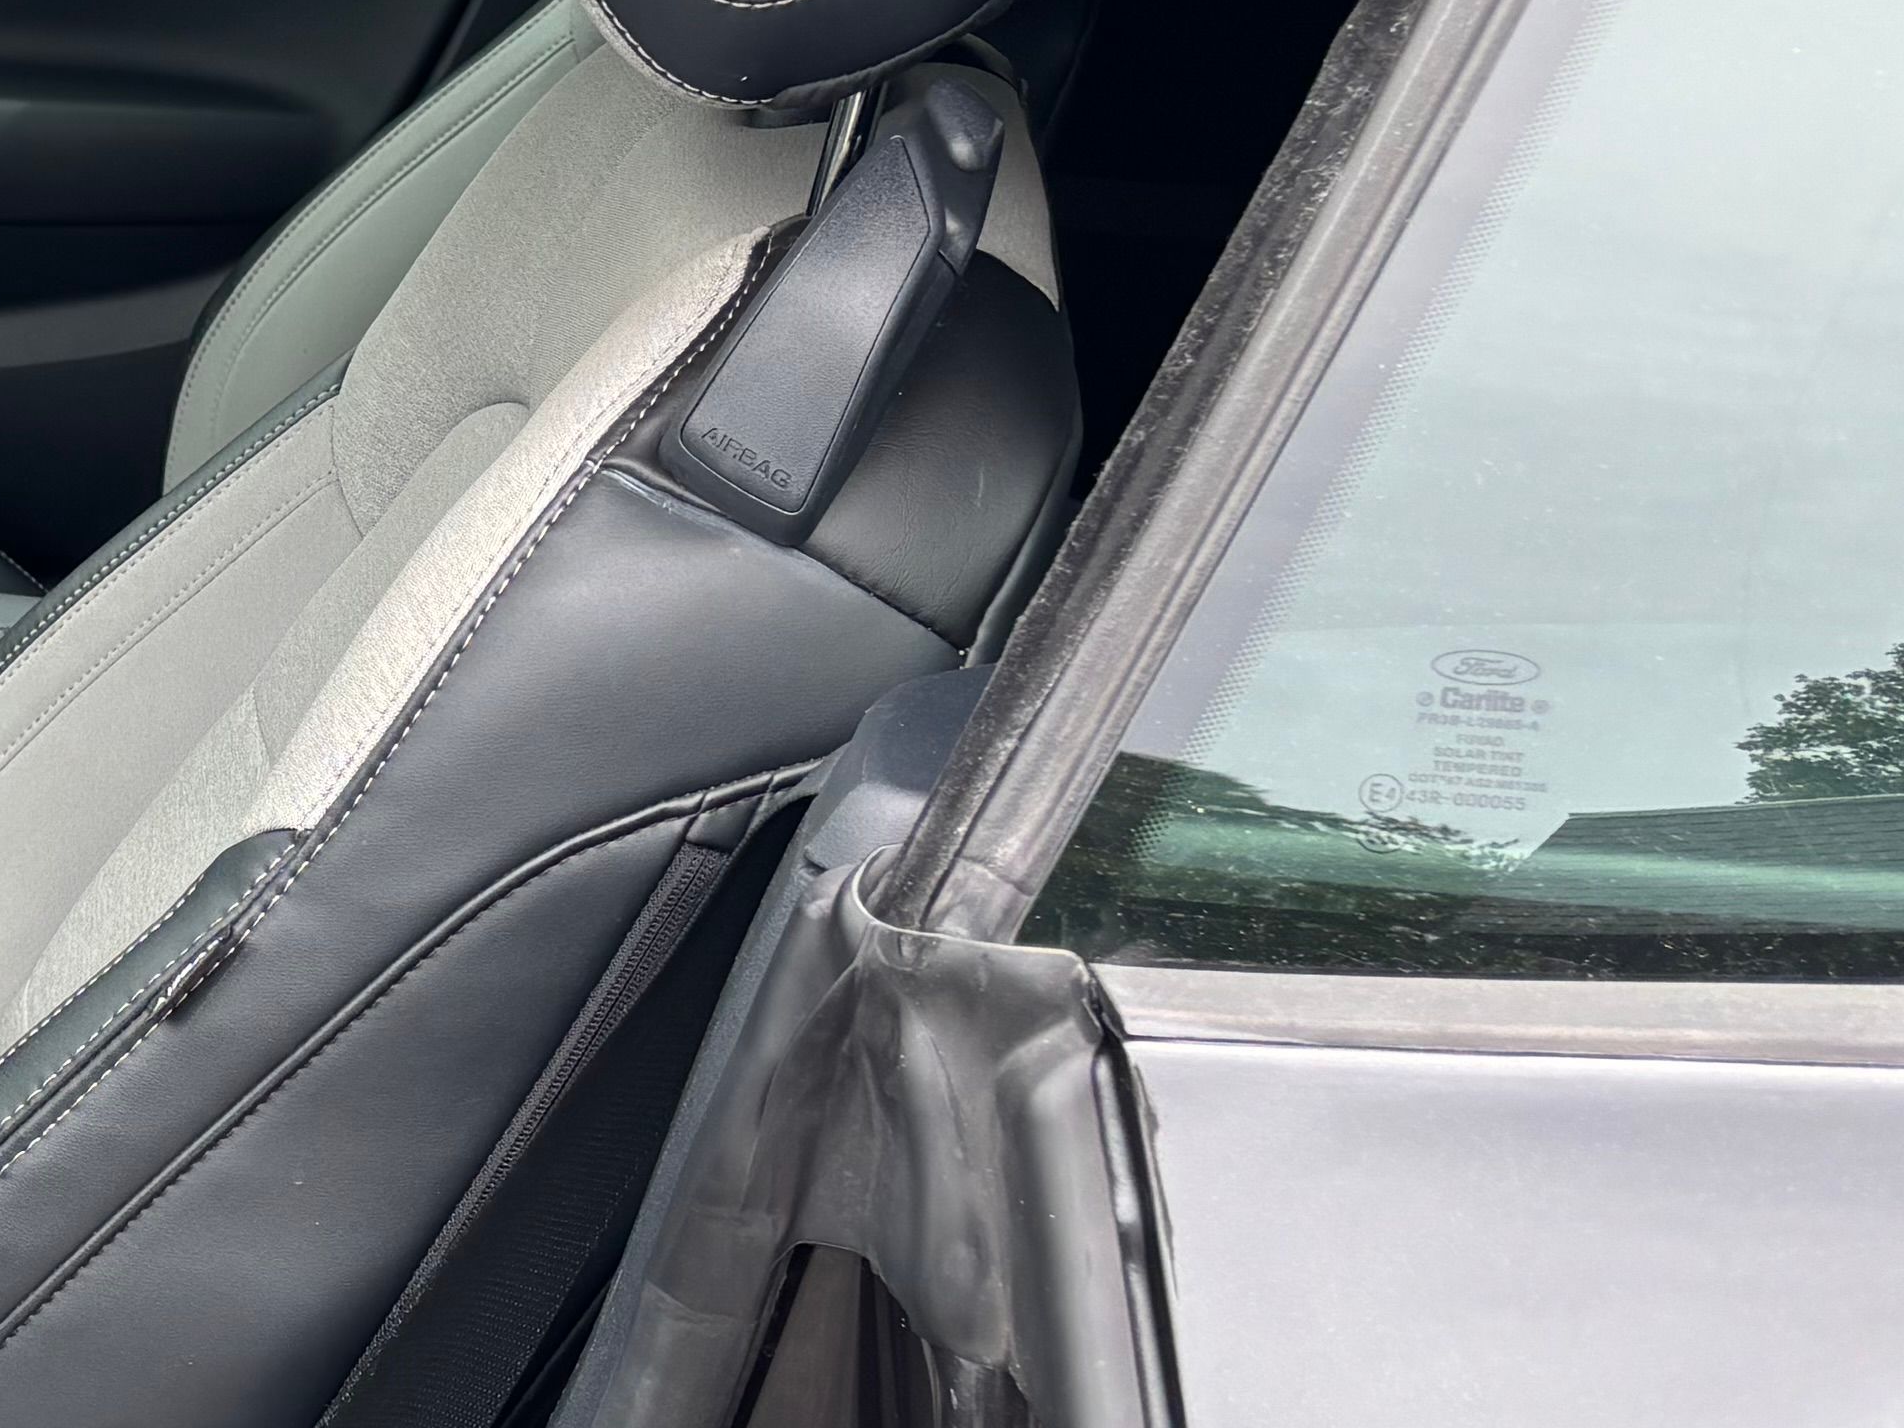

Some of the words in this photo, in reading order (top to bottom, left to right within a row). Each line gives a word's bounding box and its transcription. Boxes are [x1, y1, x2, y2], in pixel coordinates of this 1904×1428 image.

[701, 427, 792, 489] AIRBAG
[1440, 686, 1525, 713] Carlite
[1433, 746, 1486, 760] SOLAR
[1490, 750, 1525, 762] TINT
[1432, 760, 1522, 778] TEMPERED
[1369, 782, 1397, 803] E4
